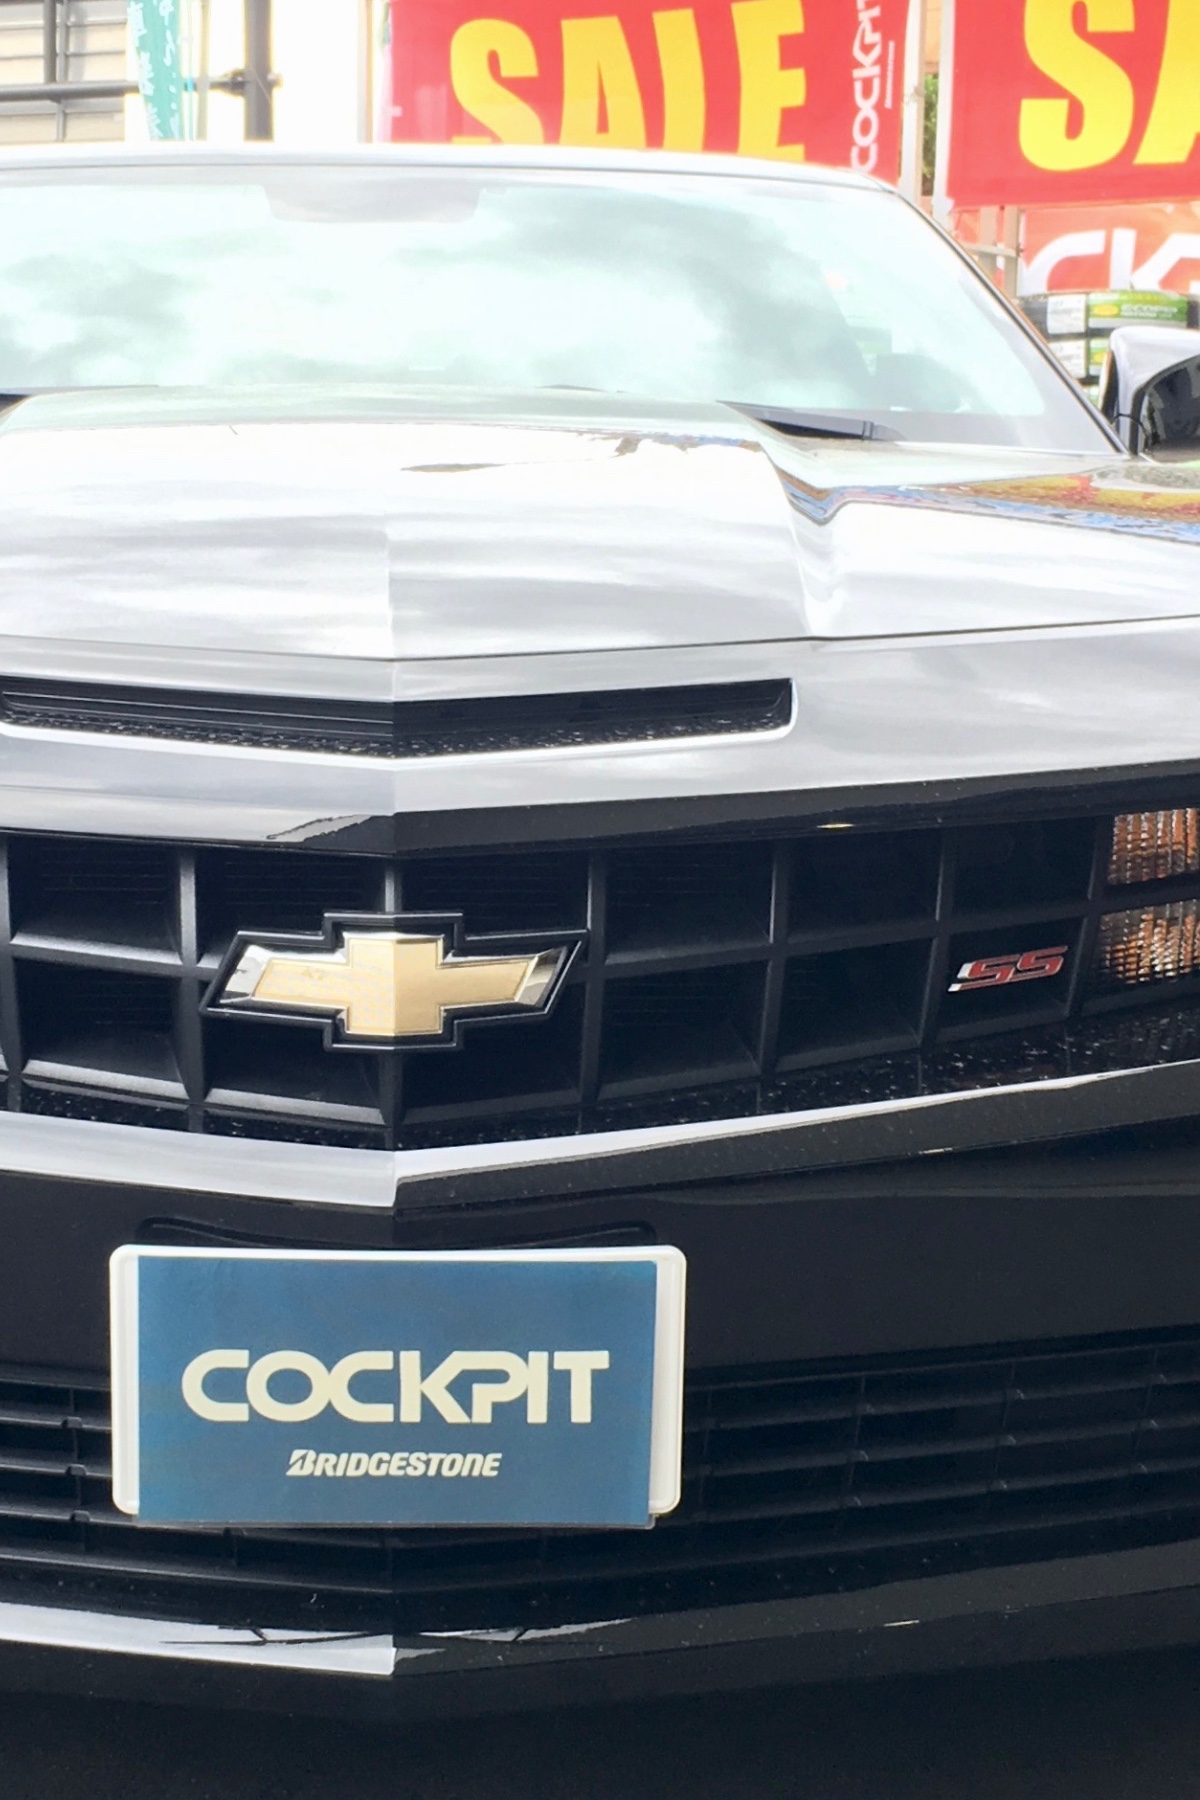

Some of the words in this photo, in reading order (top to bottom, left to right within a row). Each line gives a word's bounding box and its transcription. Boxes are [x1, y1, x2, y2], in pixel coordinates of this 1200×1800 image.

[450, 0, 806, 162] SALE
[851, 0, 881, 174] COCKPI
[948, 945, 1068, 992] SS
[181, 1349, 610, 1423] COCKPIT
[286, 1448, 503, 1477] BRIDGESTONE
